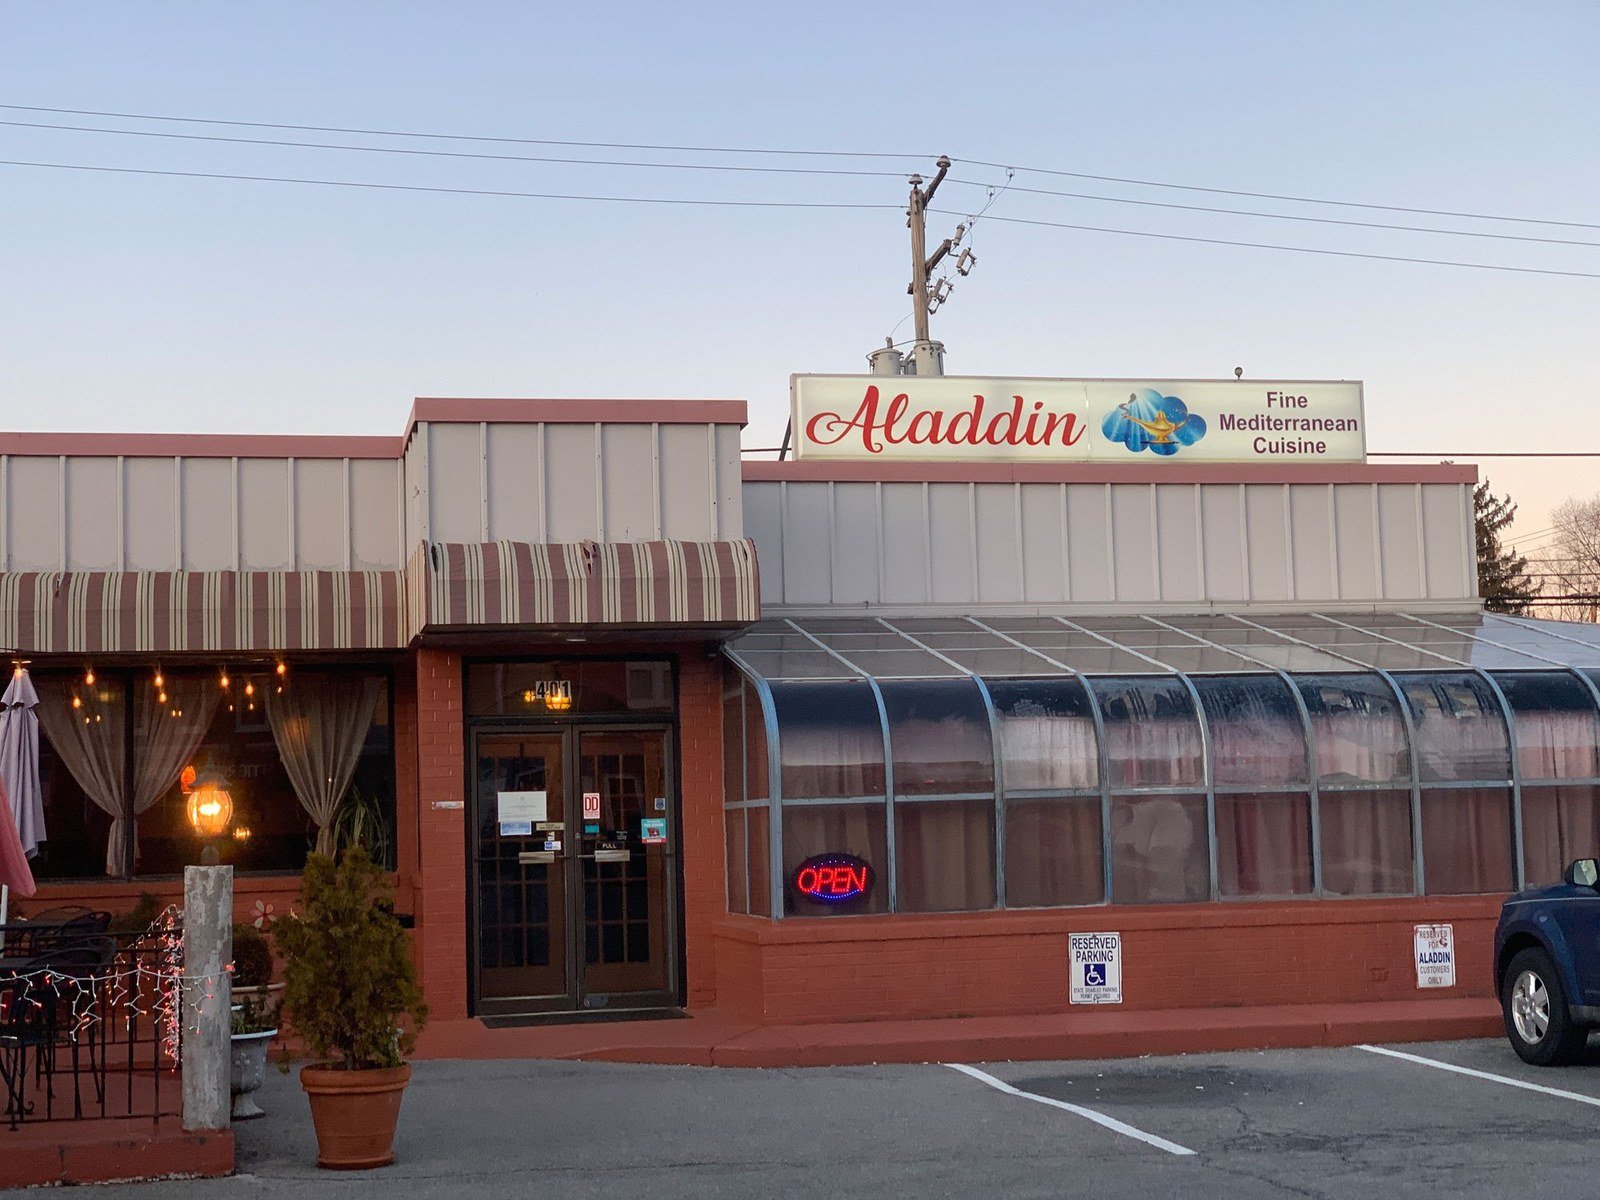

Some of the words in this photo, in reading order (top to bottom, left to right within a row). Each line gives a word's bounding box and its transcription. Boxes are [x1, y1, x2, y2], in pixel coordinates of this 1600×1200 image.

[1266, 391, 1309, 409] Fine
[805, 385, 1087, 453] Aladdin
[1219, 413, 1359, 432] Mediterranean
[1253, 436, 1327, 454] Cuisine
[536, 681, 569, 699] 401
[797, 865, 867, 893] OPEN
[1419, 930, 1448, 939] RESERVED
[1071, 937, 1117, 950] RESERVED
[1428, 941, 1439, 949] FOR
[1075, 950, 1114, 963] PARKING
[1419, 951, 1451, 964] ALADDIN
[1419, 965, 1451, 974] CUSTOMERS
[1427, 976, 1443, 985] ONLY
